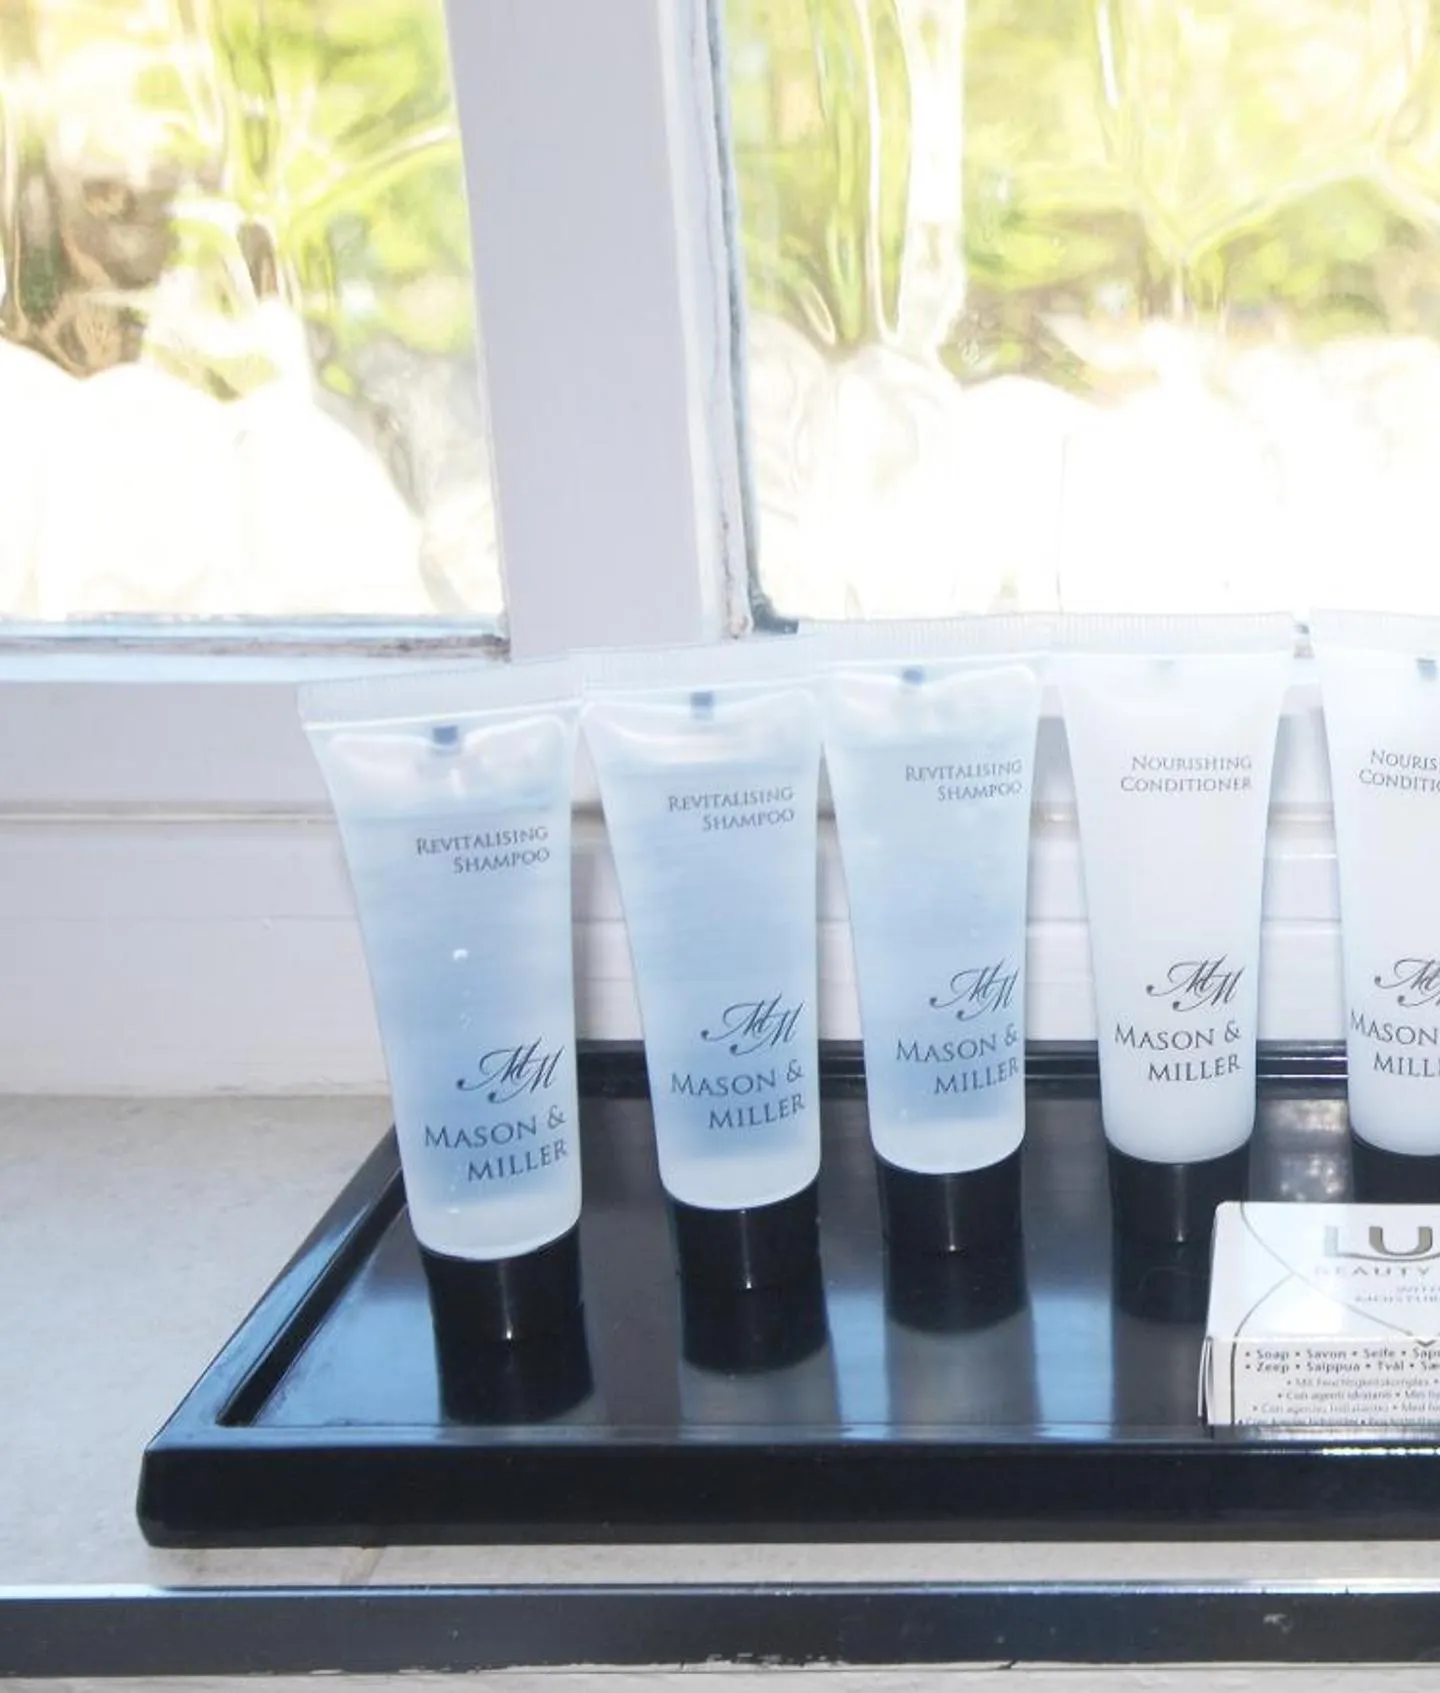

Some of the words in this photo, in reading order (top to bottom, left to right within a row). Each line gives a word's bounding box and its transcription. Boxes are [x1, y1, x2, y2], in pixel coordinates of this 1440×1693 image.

[905, 758, 1023, 782] REVITALISING
[1131, 754, 1253, 773] NOURISHING
[667, 785, 796, 812] REVITALISING
[937, 779, 1023, 802] SHAMPOO
[1120, 775, 1251, 793] CONDITIONER
[702, 806, 796, 832] SHAMPOO
[415, 825, 551, 855] REVITALISING
[453, 846, 551, 874] SHAMPOO
[895, 1038, 997, 1064] MASON
[1003, 1021, 1019, 1048] &
[1114, 1023, 1215, 1051] MASON
[1223, 1019, 1241, 1044] &
[1350, 1009, 1439, 1047] MASON
[671, 1069, 777, 1098] MASON
[786, 1058, 805, 1084] &
[931, 1057, 1019, 1096] MILLER
[1148, 1053, 1241, 1082] MILLER
[708, 1091, 806, 1131] MILLER
[425, 1115, 537, 1149] MASON
[546, 1103, 567, 1129] &
[466, 1140, 568, 1183] MILLER
[1257, 1349, 1290, 1361] Soap
[1307, 1349, 1347, 1359] Savon
[1364, 1347, 1395, 1358] Seife
[1257, 1361, 1289, 1373] Zeep
[1307, 1361, 1360, 1373] Saippua
